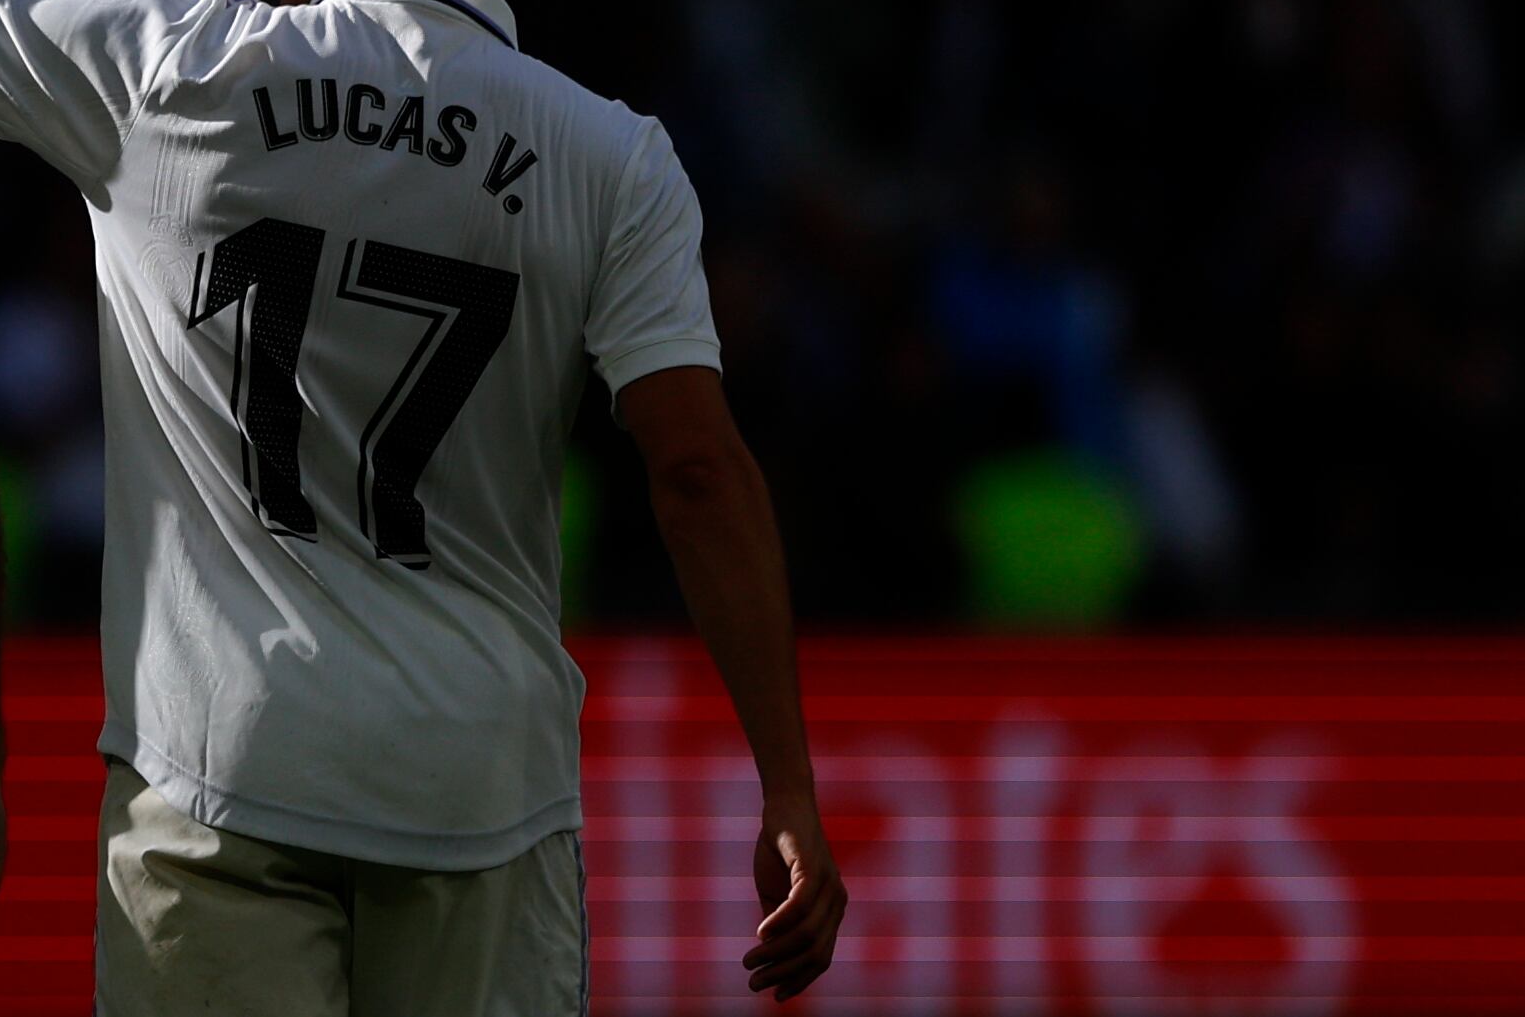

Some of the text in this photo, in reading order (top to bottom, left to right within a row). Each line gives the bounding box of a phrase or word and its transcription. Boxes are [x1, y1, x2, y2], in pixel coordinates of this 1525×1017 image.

[252, 78, 539, 216] LUCAS V.
[187, 216, 522, 572] 17
